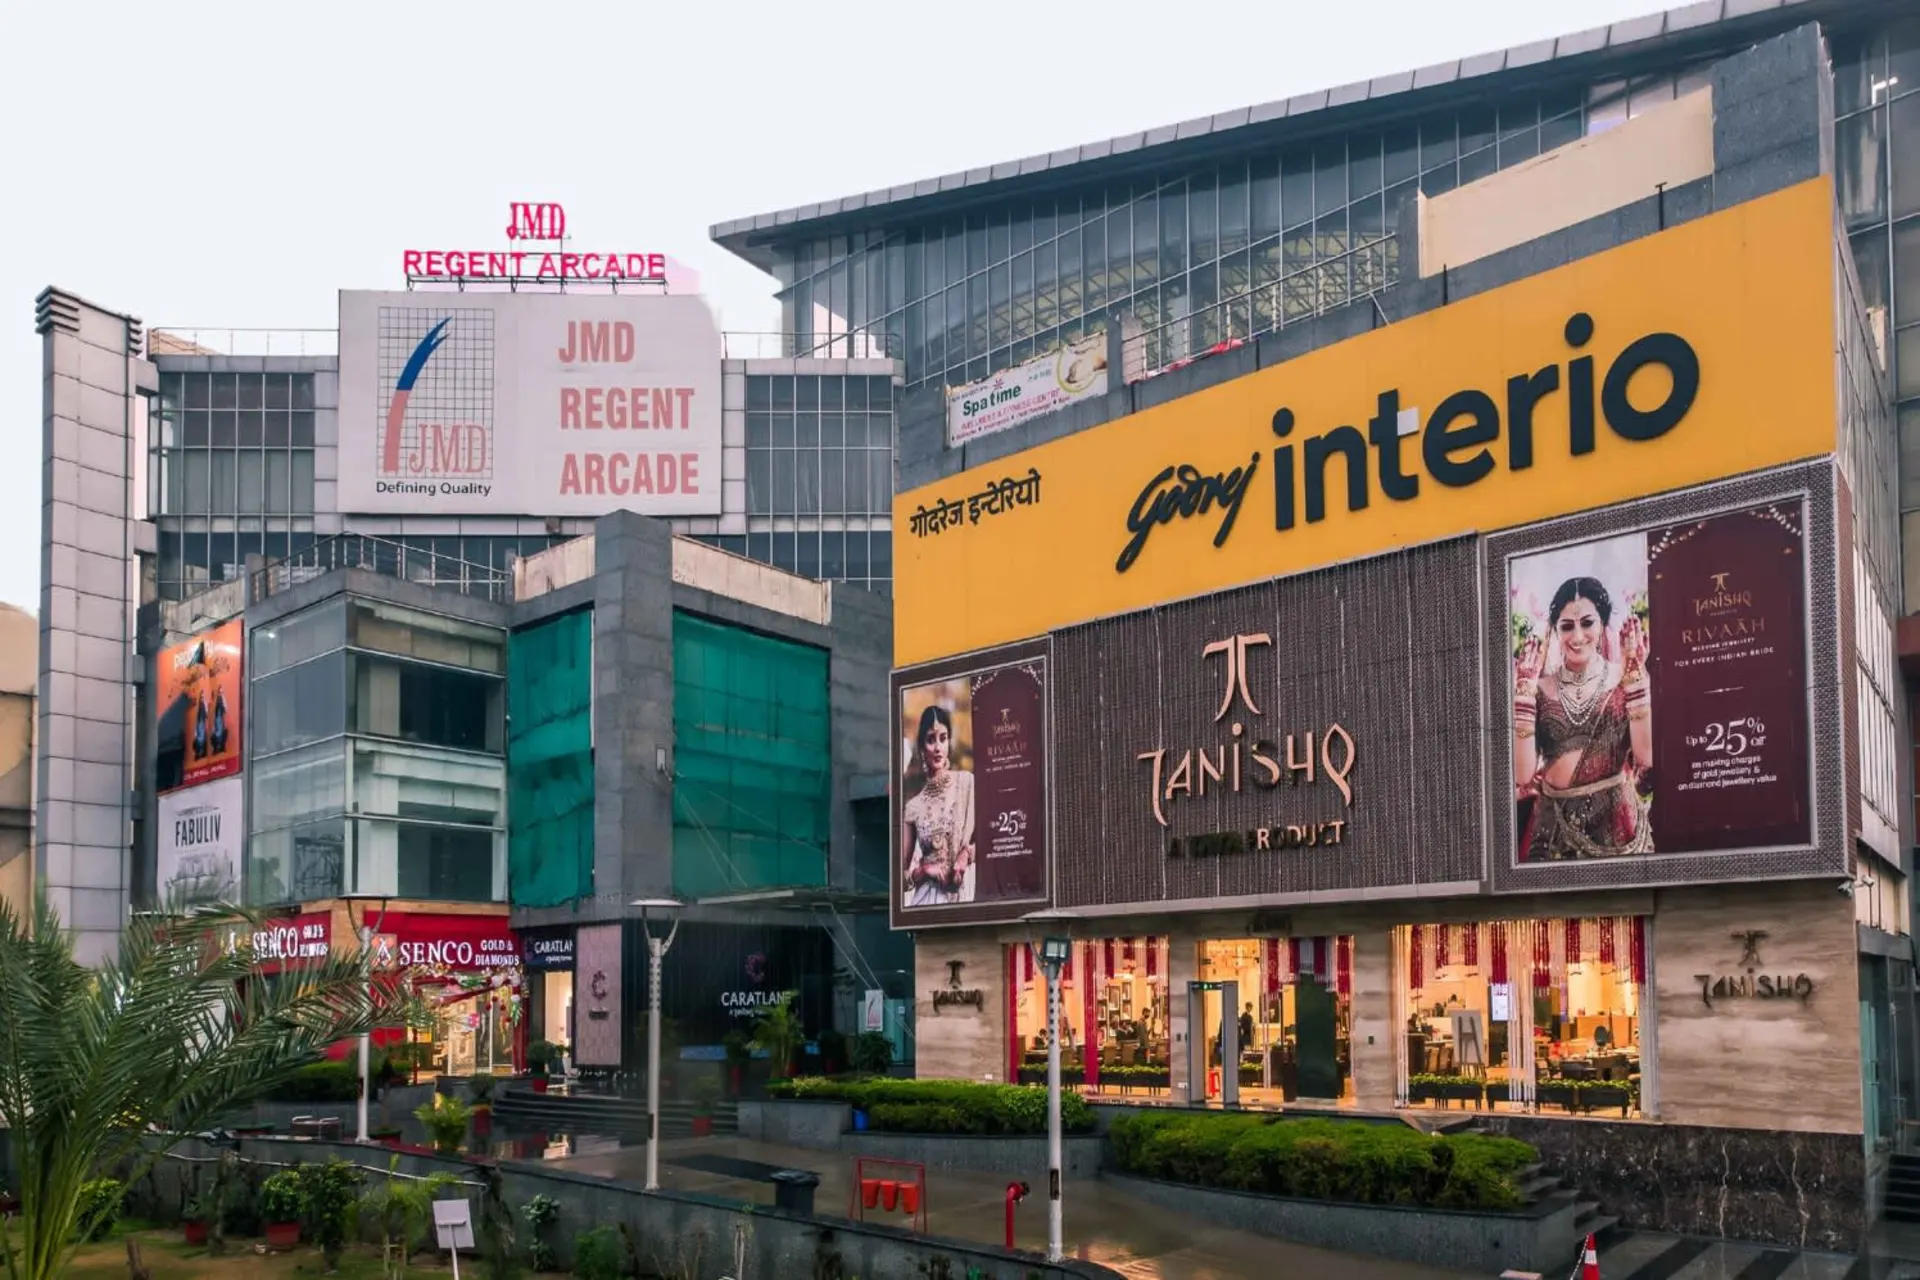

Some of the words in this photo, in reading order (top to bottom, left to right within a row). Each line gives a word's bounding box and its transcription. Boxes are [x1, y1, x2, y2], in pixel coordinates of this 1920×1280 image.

[507, 202, 566, 240] JMD
[404, 249, 527, 277] REGENT
[538, 252, 666, 279] ARCADE
[558, 320, 635, 364] JMD
[560, 387, 695, 430] REGENT
[963, 399, 988, 417] Spa
[990, 384, 1022, 407] time
[409, 423, 486, 473] JMD
[1116, 451, 1261, 574] Godrej
[1273, 313, 1699, 531] interio
[376, 481, 436, 497] Defining
[440, 482, 491, 497] Quality
[559, 452, 699, 495] ARCADE
[909, 497, 965, 538] गोदरेज
[1692, 590, 1752, 617] TANISHQ
[1674, 660, 1689, 668] FOR
[1692, 655, 1715, 665] EVERY
[1718, 650, 1747, 661] INDIAN
[1750, 646, 1775, 656] BRIDE
[1685, 735, 1698, 747] Up
[1699, 735, 1707, 744] to
[1137, 722, 1356, 827] TANISHQ
[175, 814, 221, 847] FABULIV
[252, 927, 298, 964] SENCO
[400, 939, 473, 966] SENCO
[475, 954, 520, 966] DIAMONDS
[480, 939, 505, 951] GOLD
[1693, 967, 1813, 1010] TANISHQ
